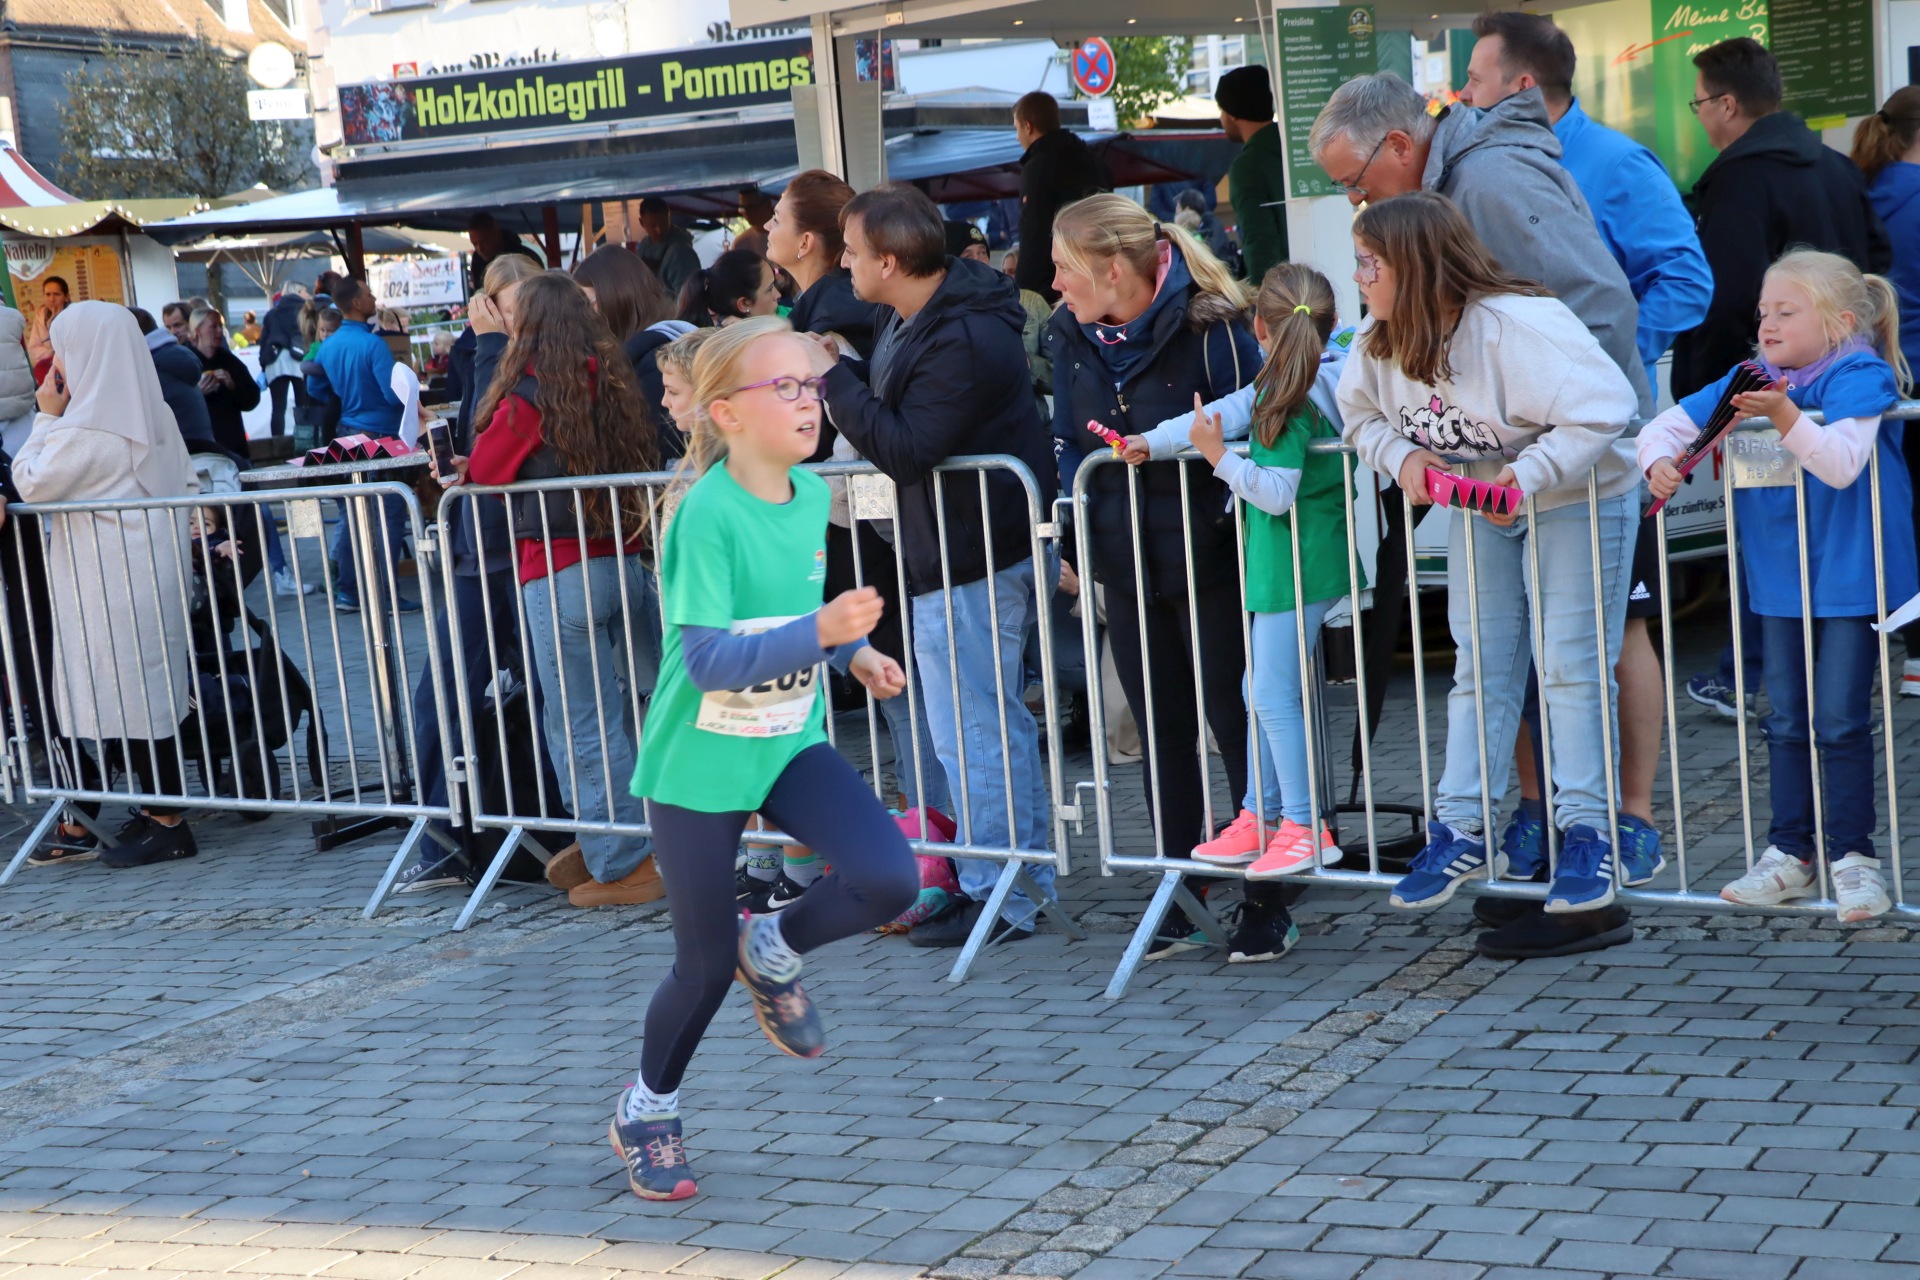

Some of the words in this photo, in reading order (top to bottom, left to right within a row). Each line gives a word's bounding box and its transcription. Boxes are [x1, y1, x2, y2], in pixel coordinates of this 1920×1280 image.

[1283, 17, 1314, 27] Preisliste
[1664, 5, 1729, 30] Meine
[415, 68, 627, 127] Holzkohlegrill
[637, 85, 652, 94] -
[662, 56, 811, 102] Pommes
[383, 281, 409, 298] 2024
[1665, 506, 1679, 517] der
[1681, 500, 1717, 513] zünftige
